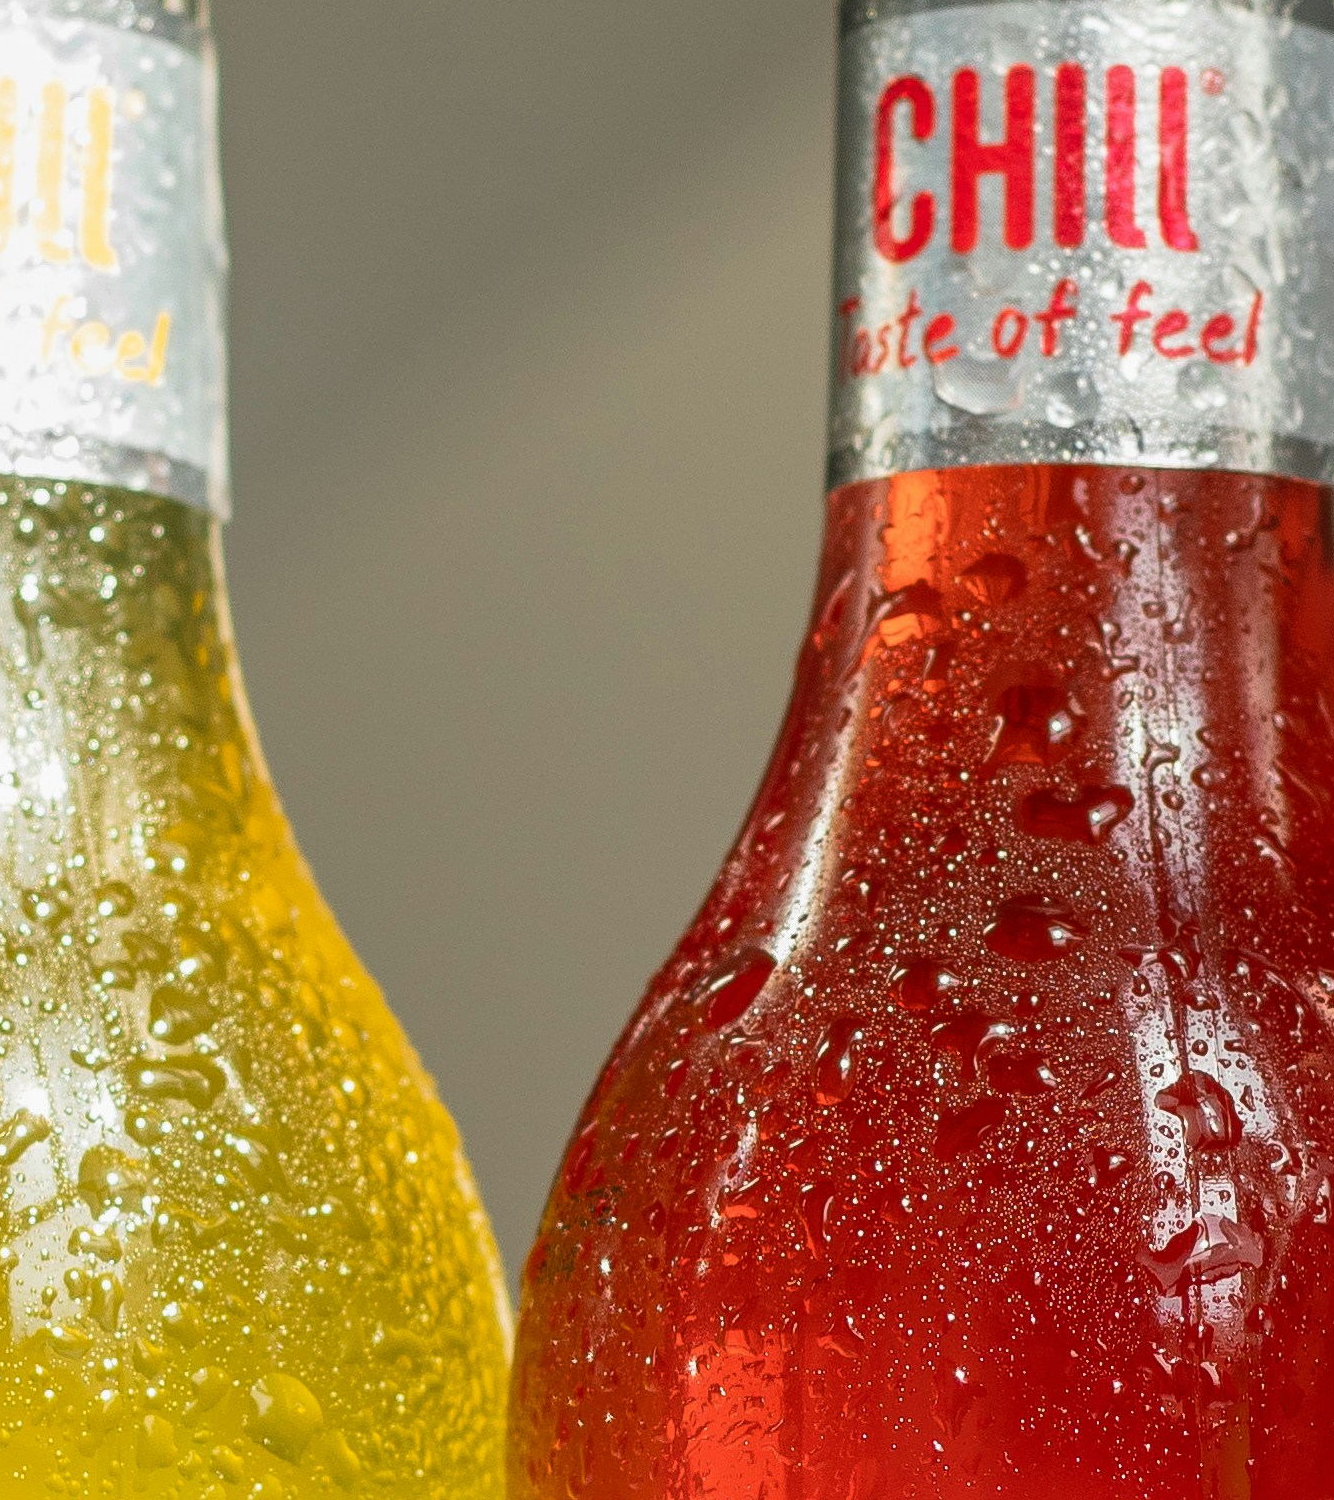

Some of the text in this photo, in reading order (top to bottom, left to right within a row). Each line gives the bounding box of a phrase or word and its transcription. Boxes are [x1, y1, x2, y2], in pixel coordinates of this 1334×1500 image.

[872, 61, 1200, 264] CHILL
[991, 276, 1079, 358] of
[1110, 279, 1263, 367] feel
